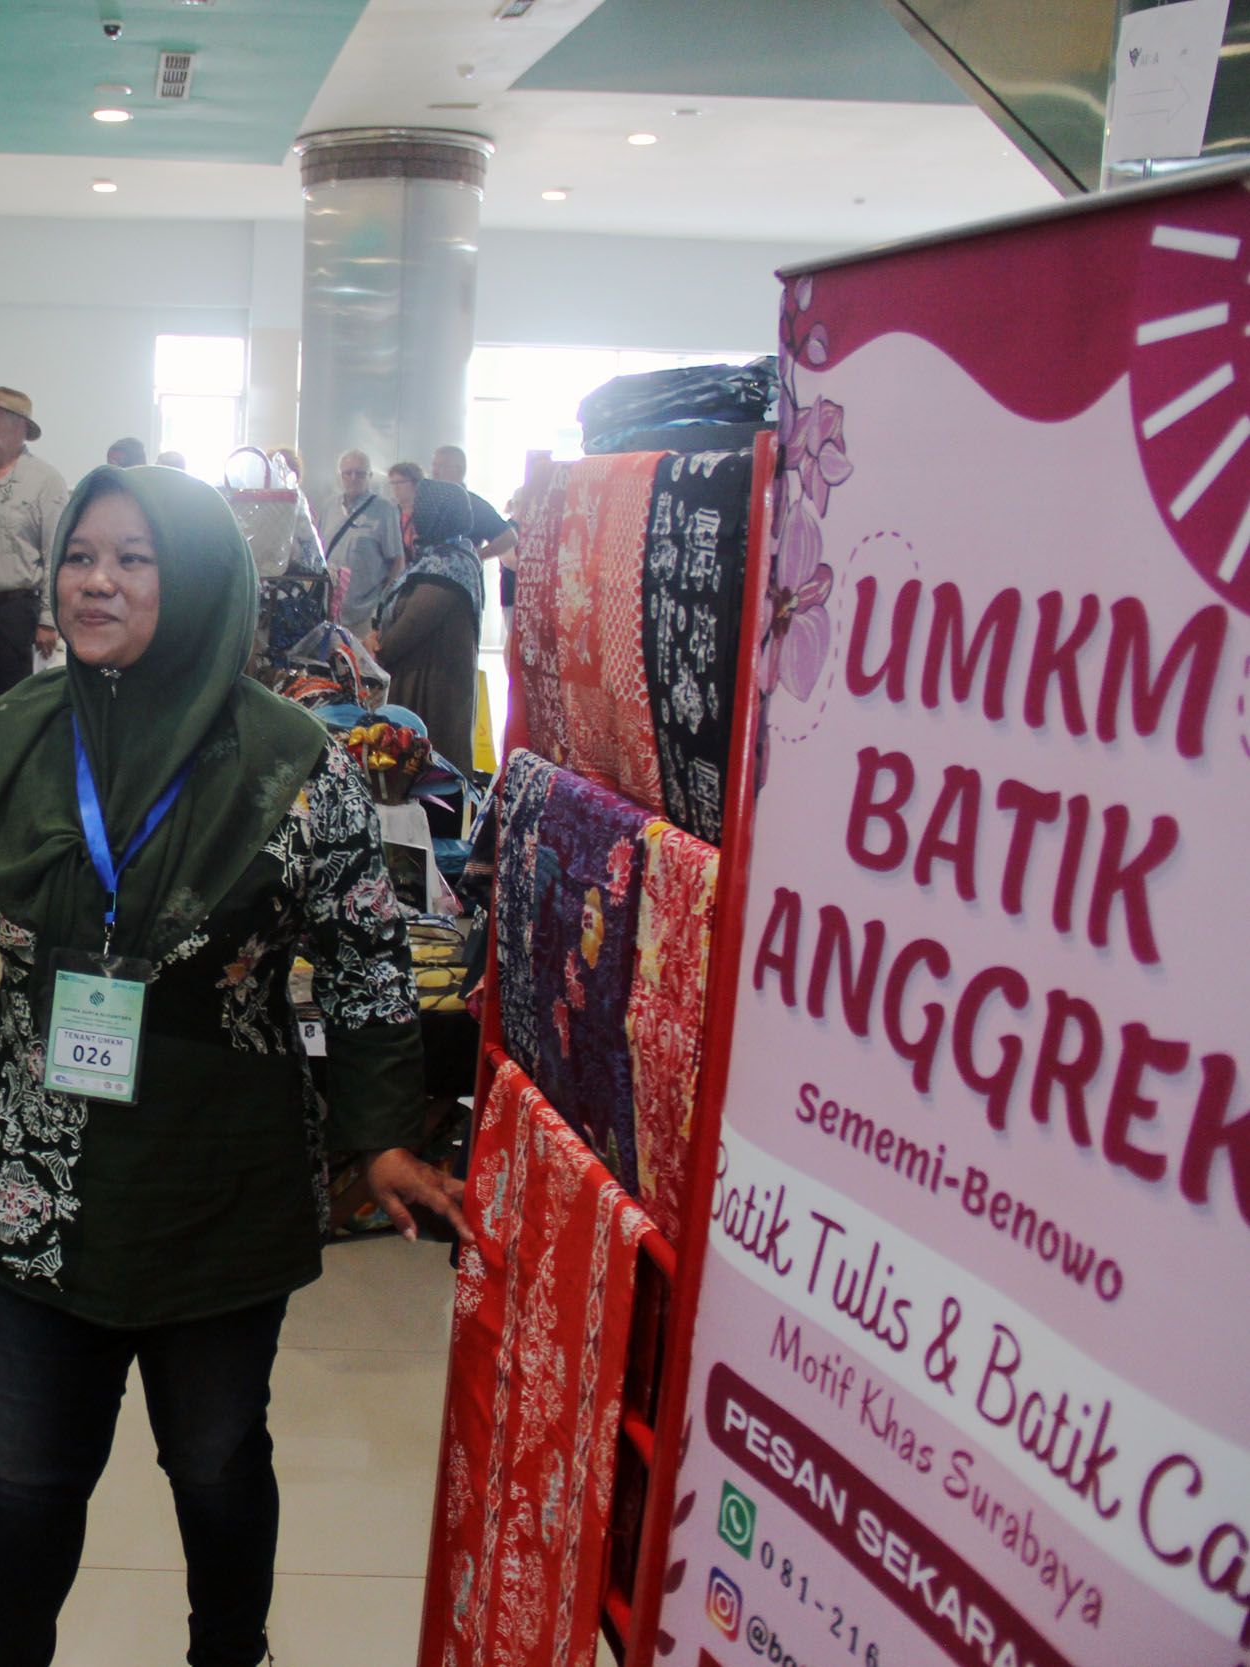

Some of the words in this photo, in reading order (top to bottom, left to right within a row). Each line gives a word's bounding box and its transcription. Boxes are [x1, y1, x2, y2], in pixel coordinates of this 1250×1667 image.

[846, 576, 1228, 759] UMKM
[846, 746, 1180, 965] BATIK
[64, 1031, 96, 1042] TENANT
[73, 1044, 111, 1067] 026
[753, 887, 1250, 1228] ANGGREK
[795, 1082, 1124, 1303] Sememi-Benowo
[770, 1315, 855, 1409] Motif
[860, 1379, 934, 1476] Khas
[943, 1449, 1104, 1629] Surabaya
[807, 1210, 913, 1352] Tulis
[923, 1296, 963, 1396] &
[975, 1323, 1122, 1521] Batik
[724, 1397, 848, 1527] PESAN
[855, 1509, 1036, 1667] SEKARA
